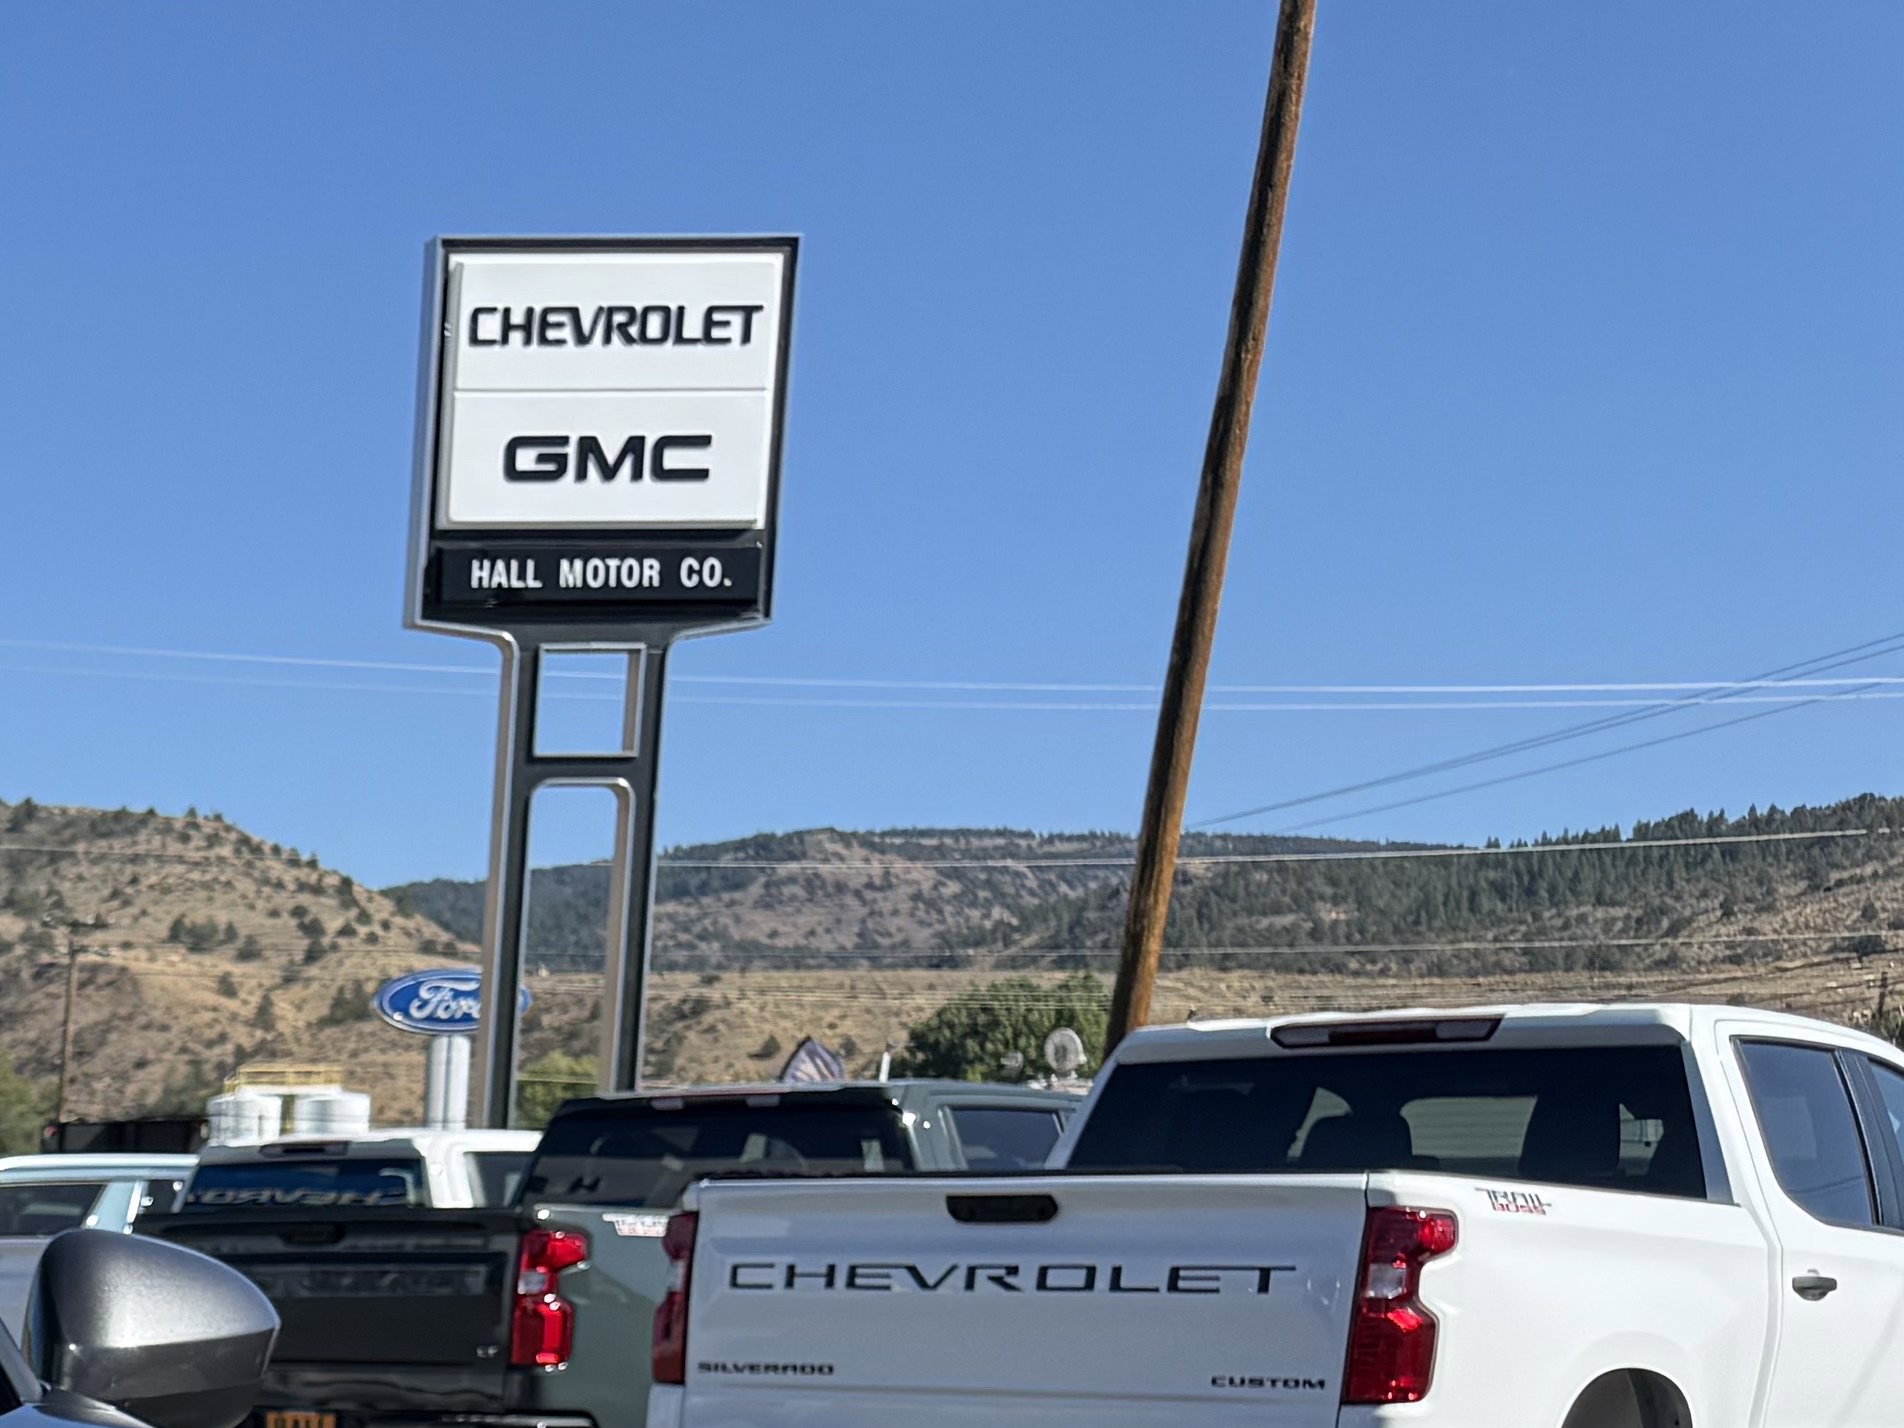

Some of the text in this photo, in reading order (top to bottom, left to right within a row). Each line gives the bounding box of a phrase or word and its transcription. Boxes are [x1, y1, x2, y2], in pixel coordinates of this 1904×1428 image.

[468, 305, 764, 347] CHEVROLET
[503, 435, 712, 483] GMC
[470, 557, 733, 588] HALL MOTOR CO.
[729, 1263, 1296, 1294] CHEVROLET
[697, 1362, 834, 1376] SILVERADO
[1211, 1375, 1326, 1390] CUSTOM
